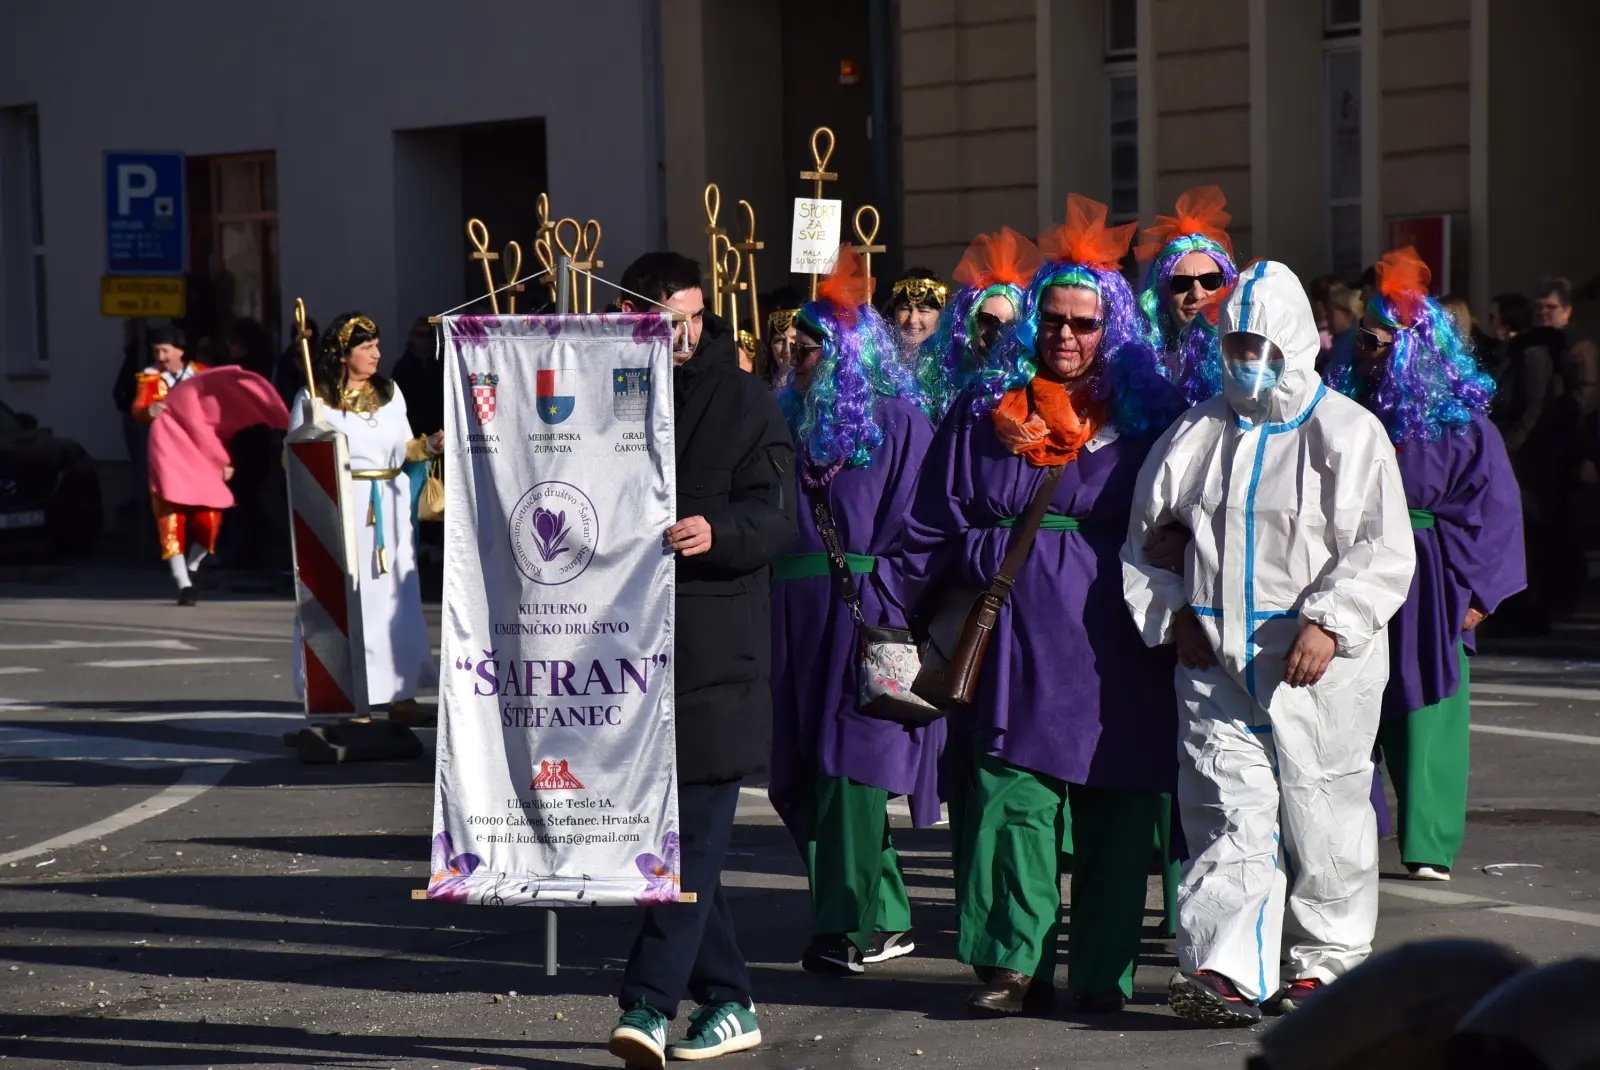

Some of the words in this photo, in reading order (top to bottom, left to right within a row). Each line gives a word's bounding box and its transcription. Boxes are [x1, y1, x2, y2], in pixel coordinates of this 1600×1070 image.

[116, 163, 157, 216] P
[798, 202, 837, 219] SPORT
[806, 219, 823, 230] ZA
[798, 229, 827, 241] SVE
[622, 431, 645, 440] GRAD
[534, 442, 573, 453] ŽUPANIJA
[544, 487, 577, 505] društvo
[519, 603, 588, 615] KULTURNO
[565, 620, 630, 635] DRUŠTVO
[503, 702, 623, 728] ŠTEFANEC
[566, 798, 596, 809] Tesle
[466, 815, 504, 826] 40000
[602, 814, 650, 825] Hrvatska
[476, 833, 515, 844] e-mail:
